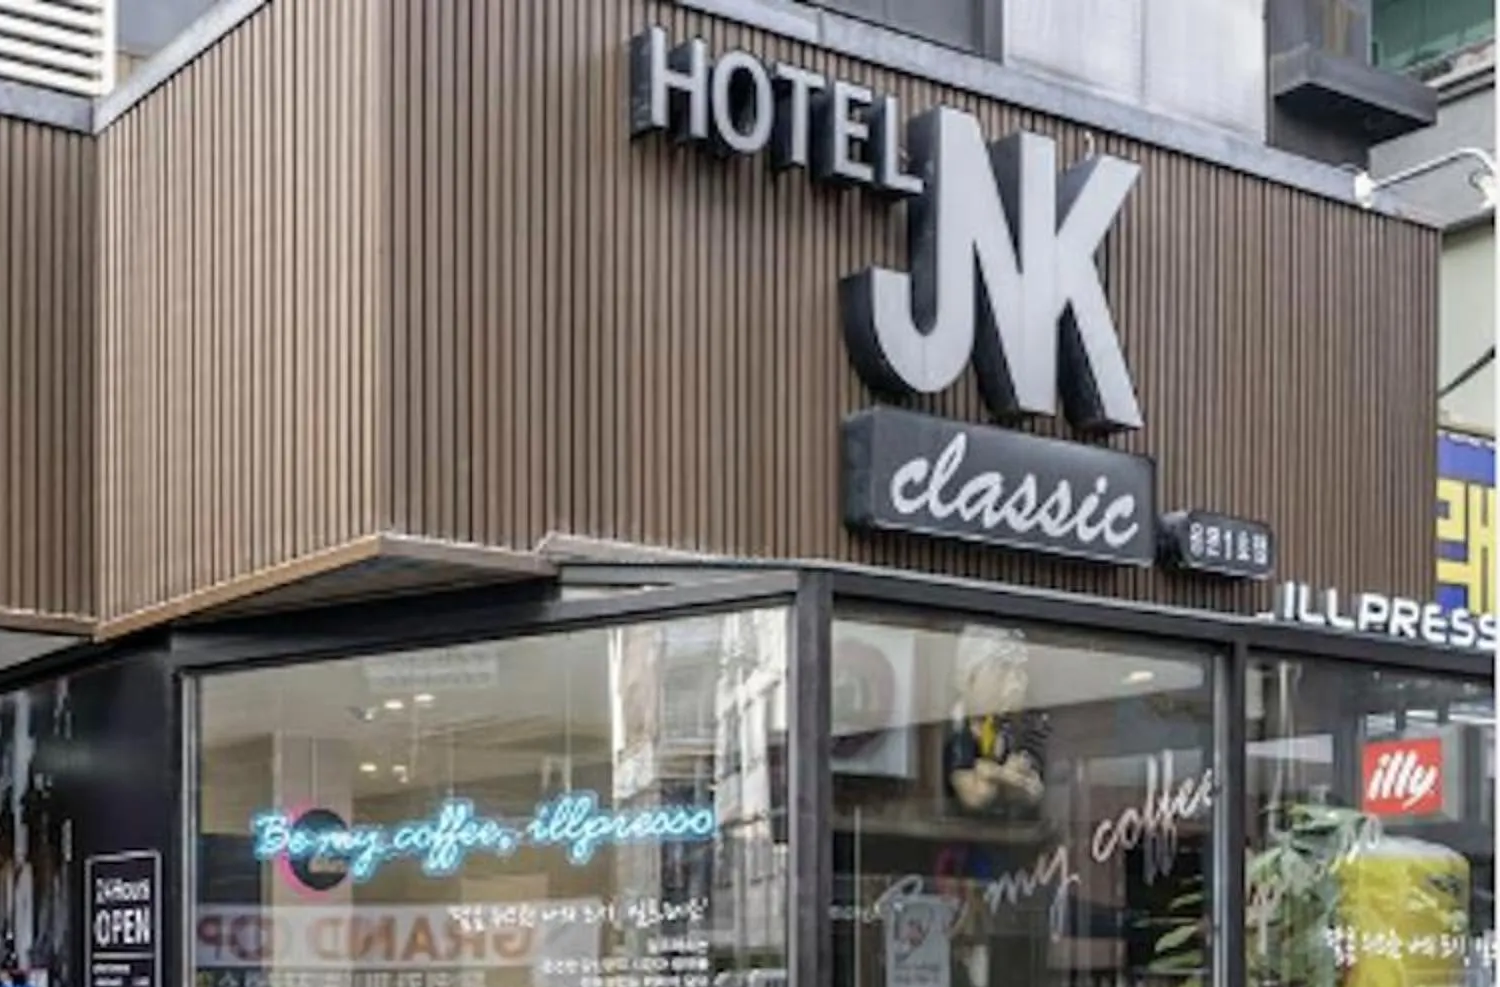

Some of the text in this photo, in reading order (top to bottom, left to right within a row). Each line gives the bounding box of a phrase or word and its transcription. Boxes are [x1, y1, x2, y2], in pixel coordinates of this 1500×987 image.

[648, 26, 924, 196] HOTEL
[870, 105, 1143, 430] JNK
[890, 432, 1141, 550] classic
[1368, 749, 1440, 811] illy
[530, 796, 716, 864] illpresso
[95, 906, 151, 946] OPEN
